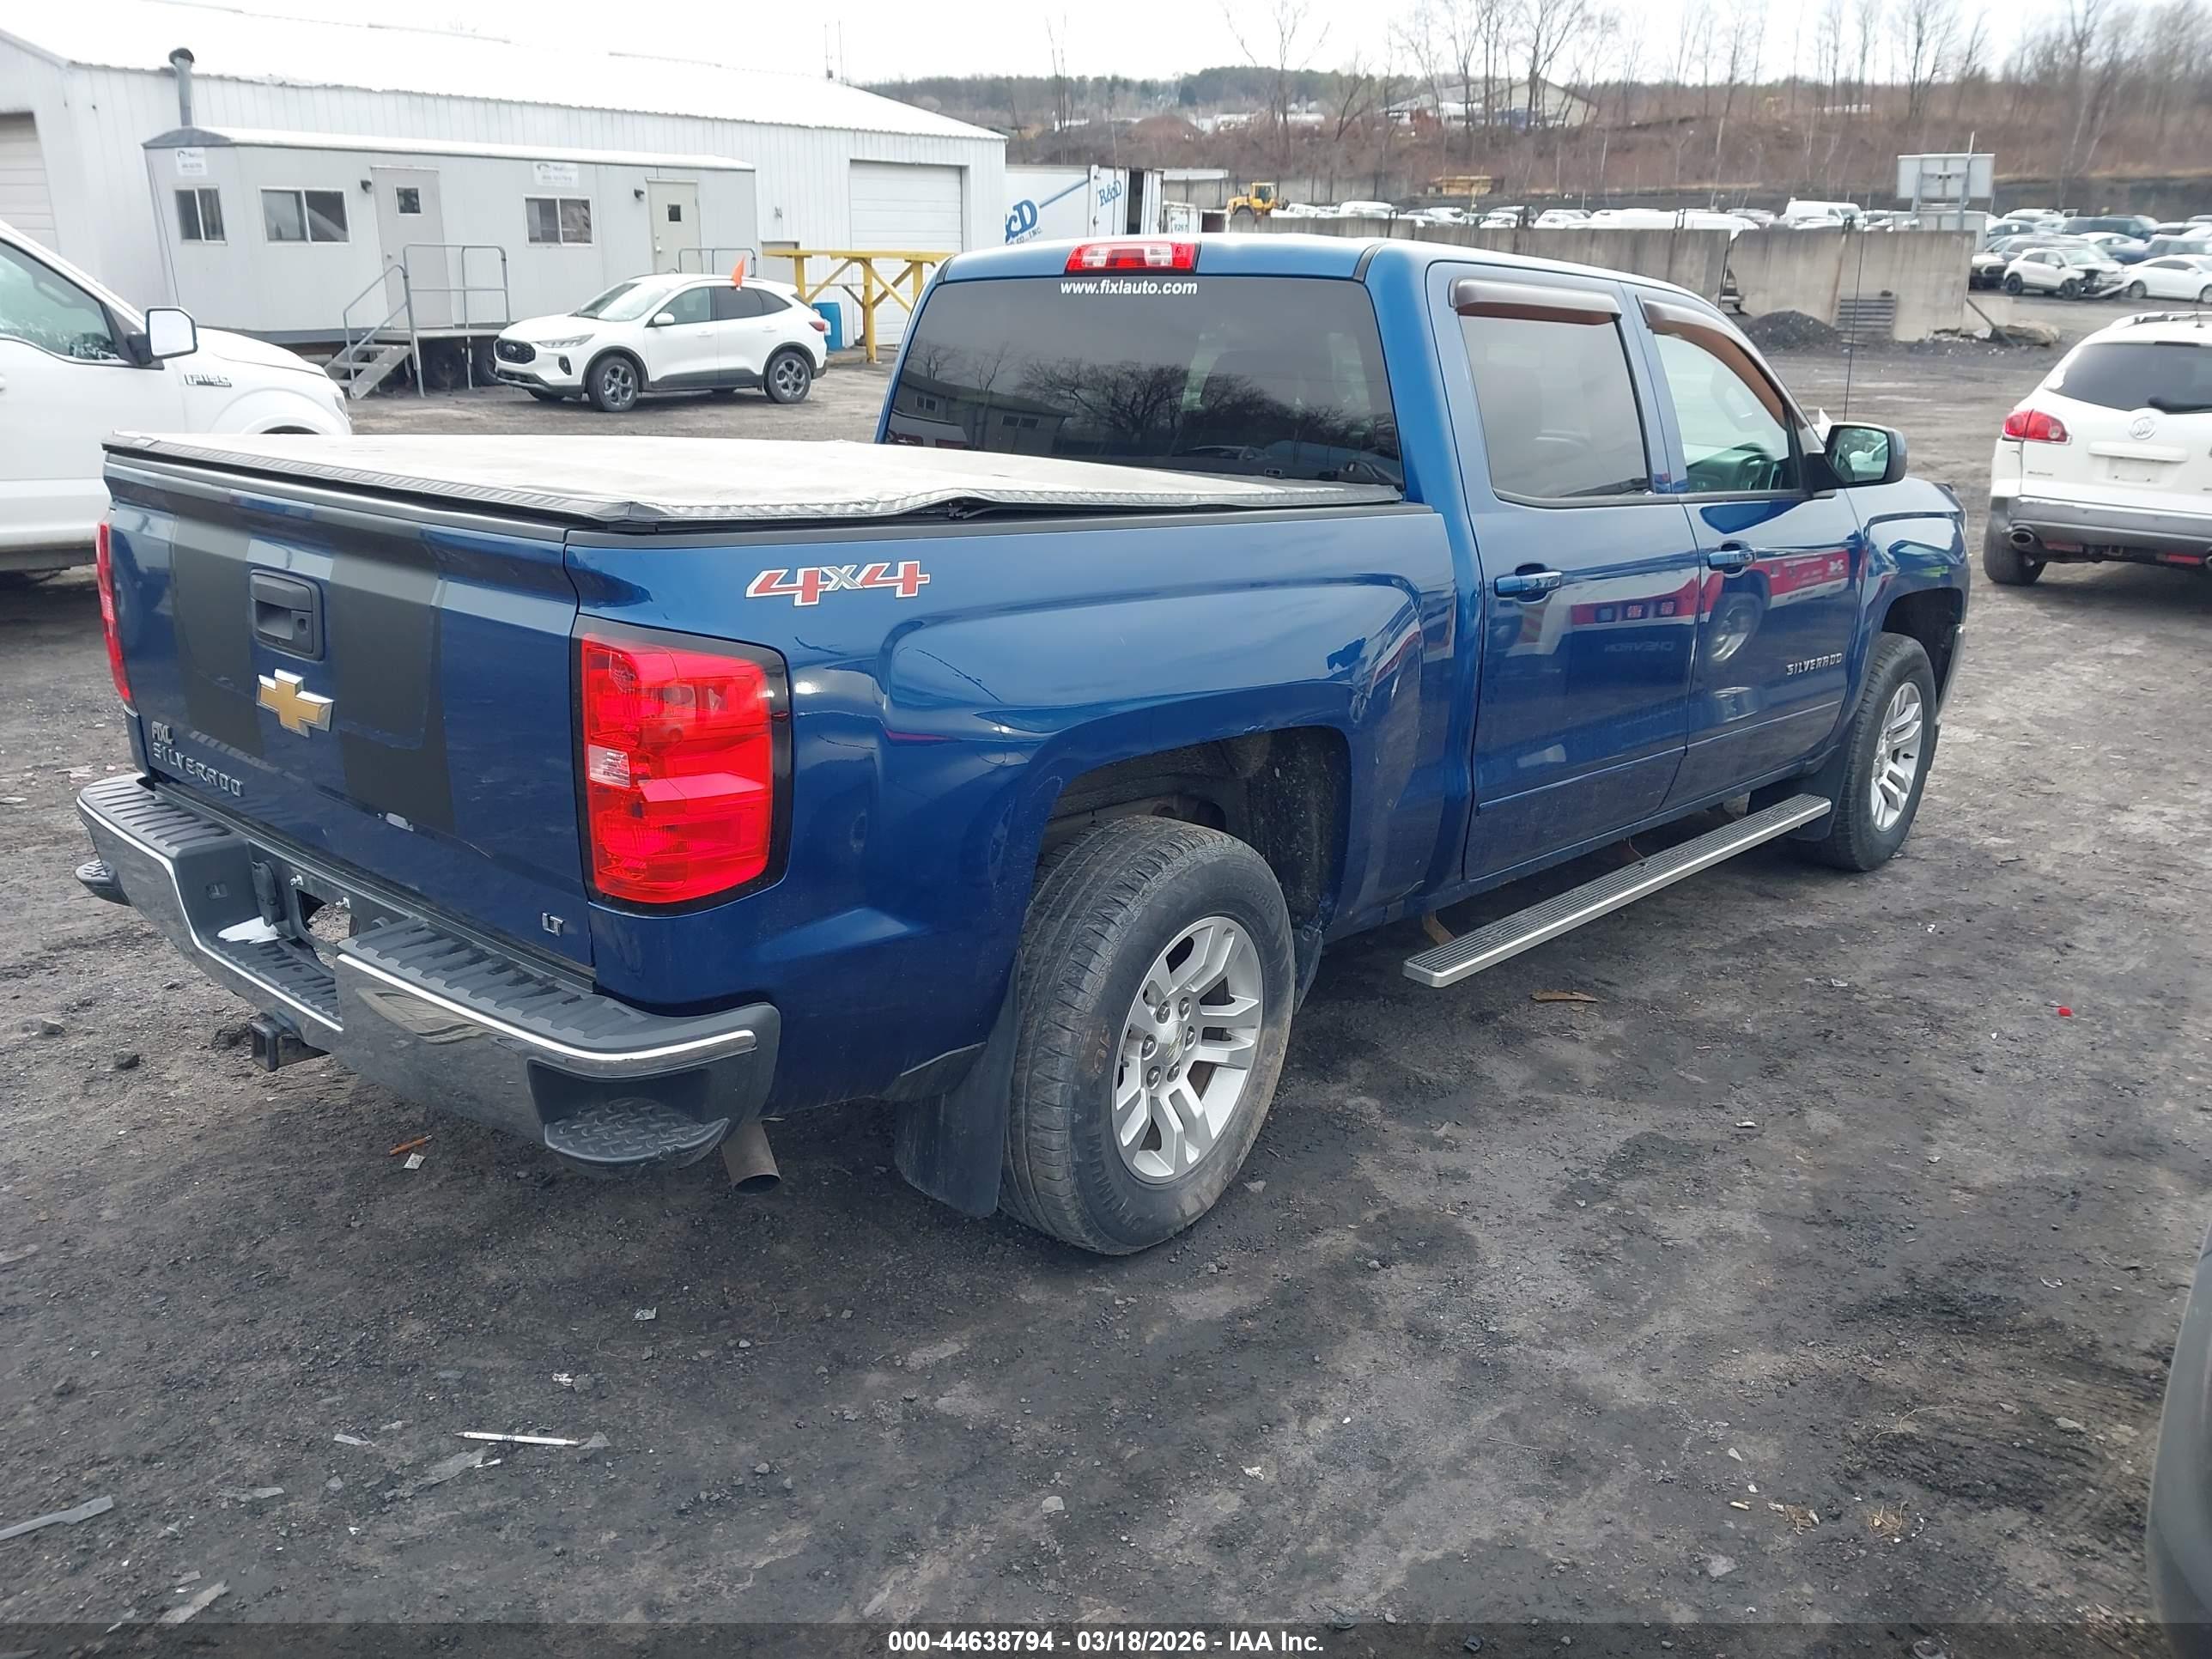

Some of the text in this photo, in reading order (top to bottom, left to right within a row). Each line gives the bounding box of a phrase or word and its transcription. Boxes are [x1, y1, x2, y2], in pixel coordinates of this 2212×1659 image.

[1060, 279, 1198, 295] www.fixlauto.com
[1786, 653, 1843, 676] SILVERADO
[153, 742, 243, 798] SILVERADO
[542, 912, 564, 937] LT
